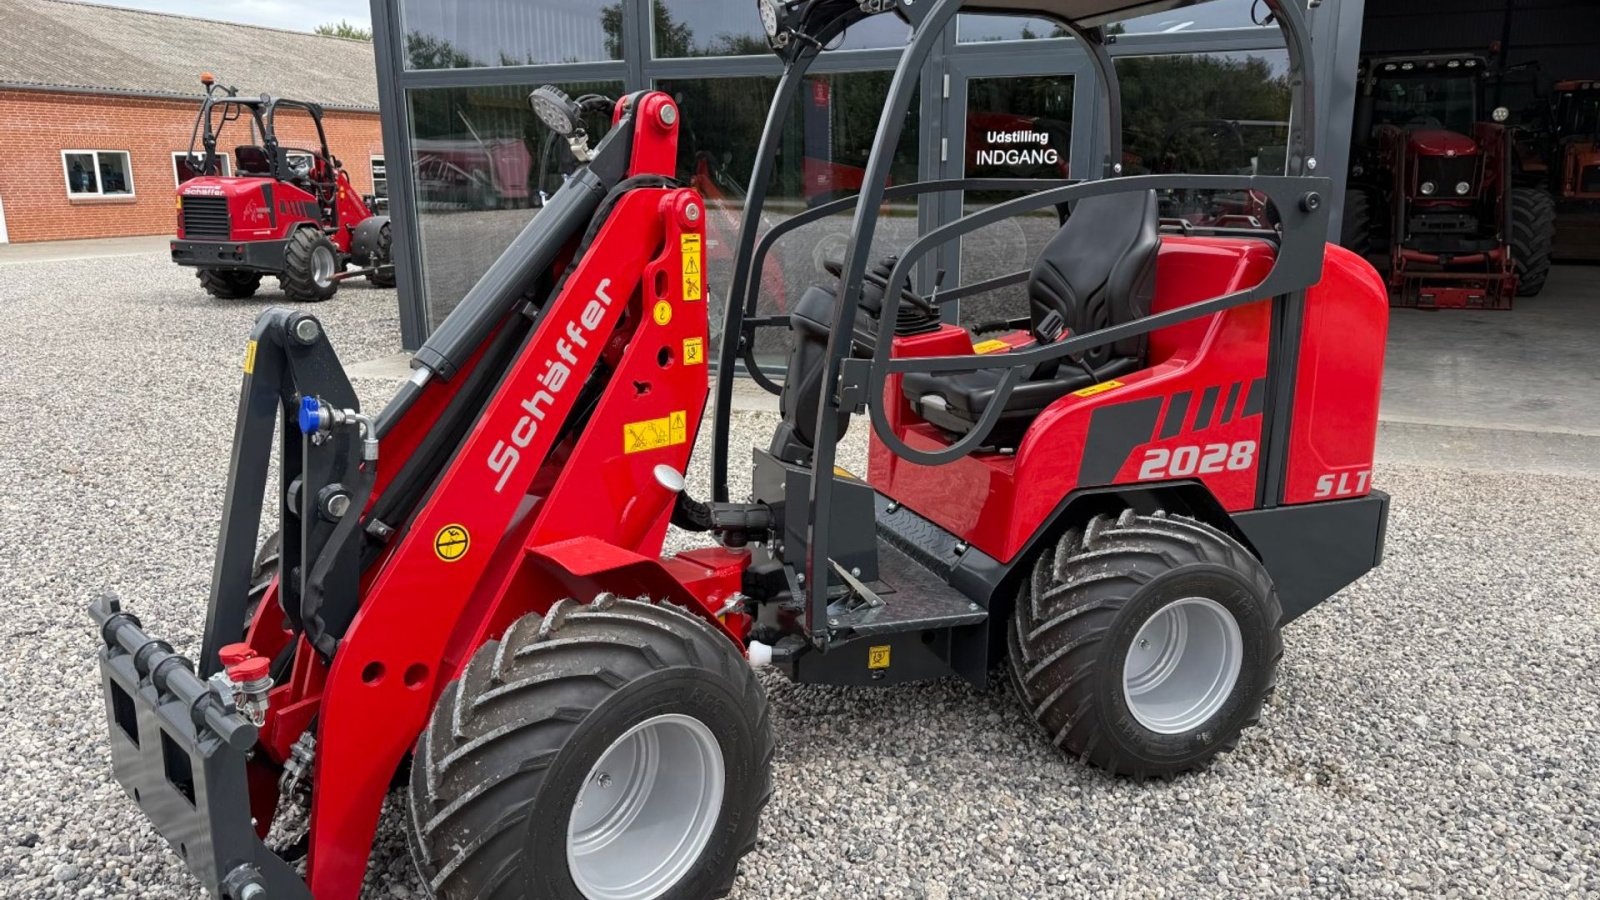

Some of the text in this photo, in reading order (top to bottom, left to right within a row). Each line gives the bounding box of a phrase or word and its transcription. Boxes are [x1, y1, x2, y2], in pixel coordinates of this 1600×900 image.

[987, 130, 1049, 145] Udstilling
[976, 149, 1058, 165] INDGANG
[487, 277, 612, 493] Schäffer
[1138, 440, 1256, 480] 2028
[1314, 470, 1371, 497] SLT
